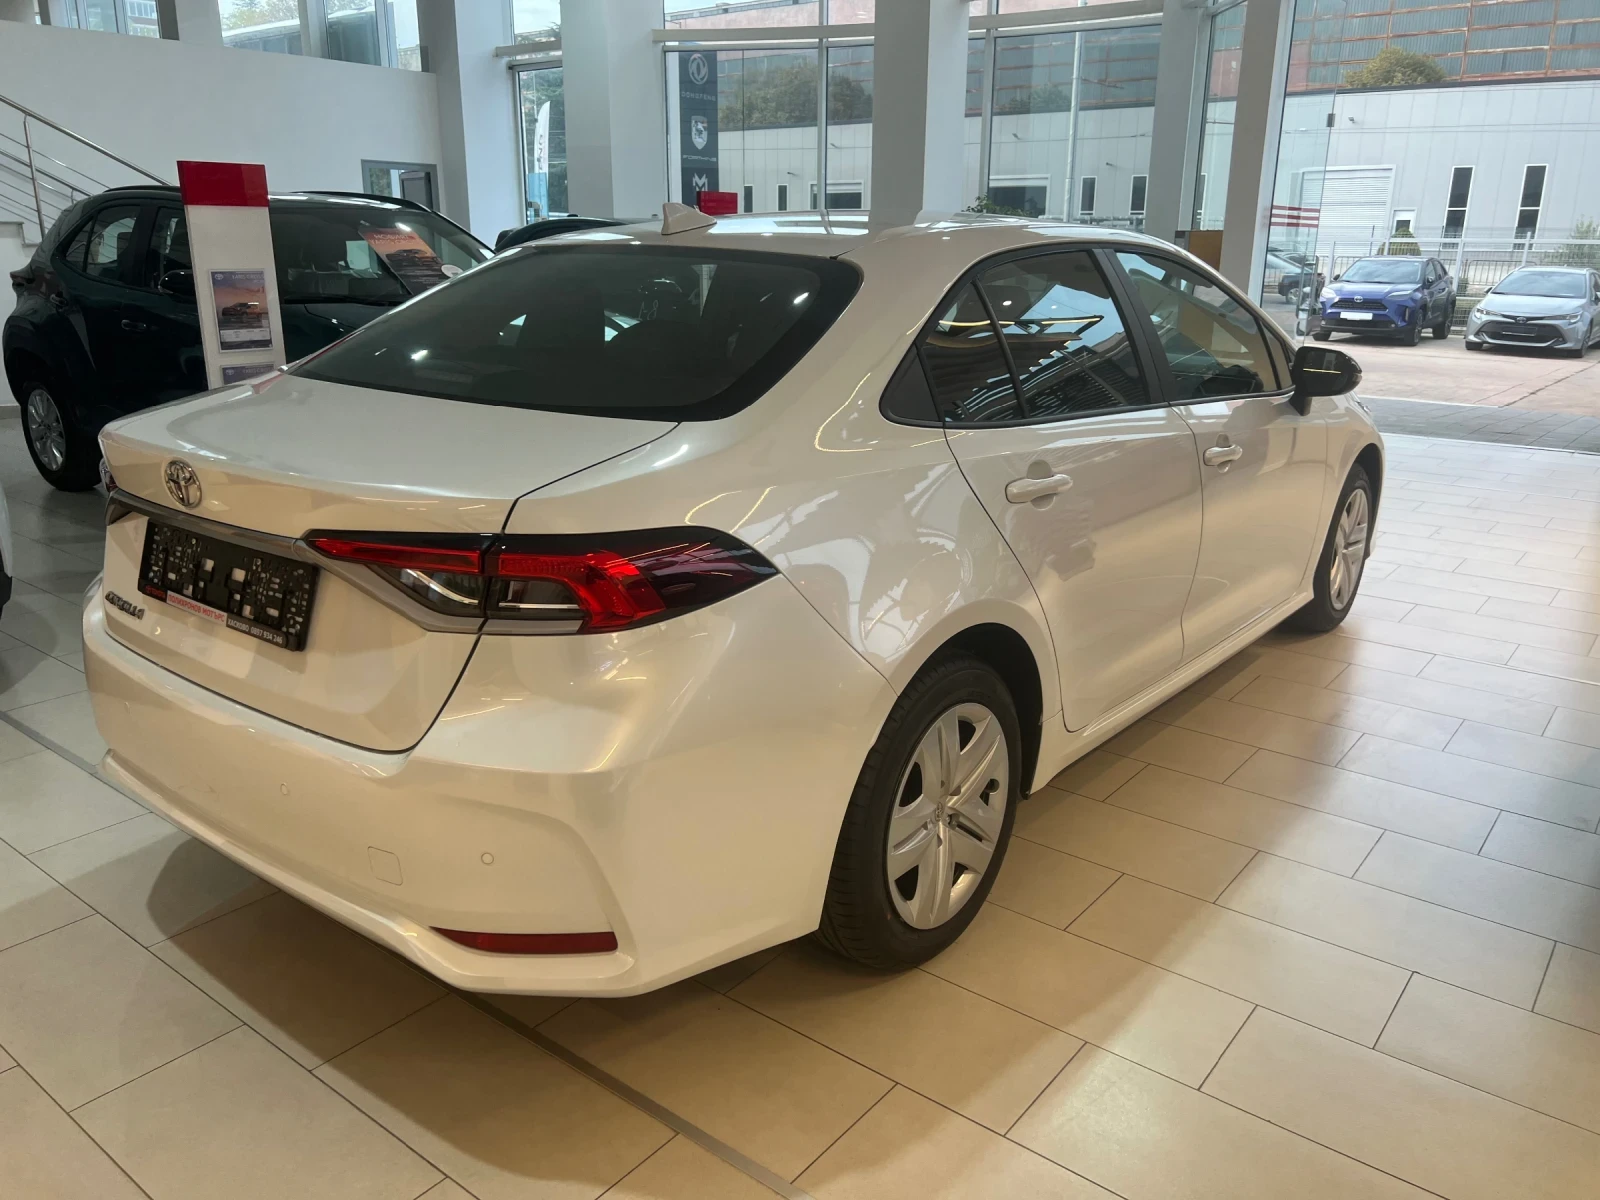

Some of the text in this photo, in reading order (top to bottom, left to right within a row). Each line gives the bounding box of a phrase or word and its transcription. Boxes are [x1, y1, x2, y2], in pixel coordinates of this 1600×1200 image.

[202, 606, 225, 622] МОТЪРС
[227, 618, 283, 644] ХАСКОВО 0897 934 246
